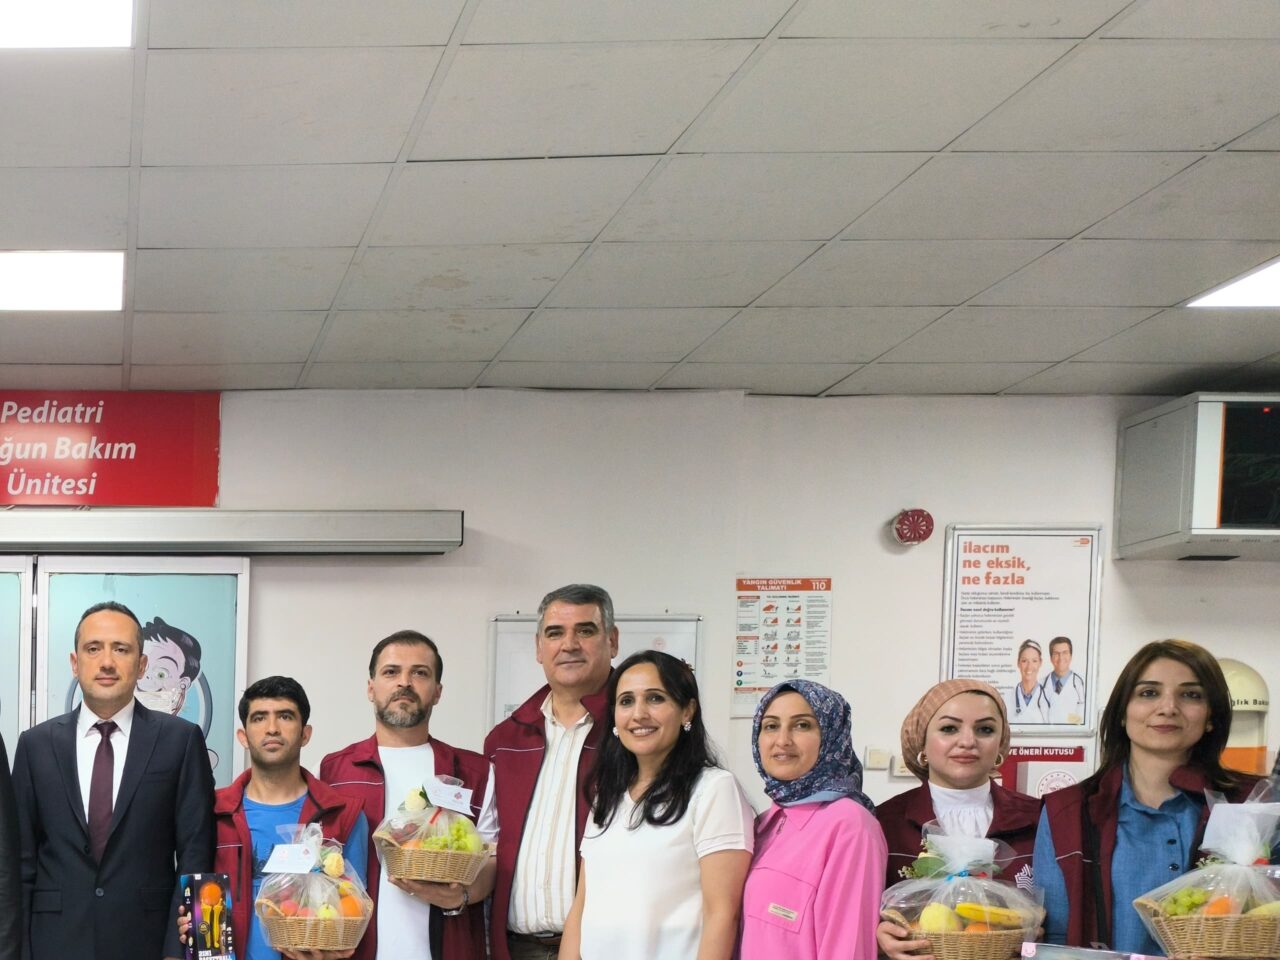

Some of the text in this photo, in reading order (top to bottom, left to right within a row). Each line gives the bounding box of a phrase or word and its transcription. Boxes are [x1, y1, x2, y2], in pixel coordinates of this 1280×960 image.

[0, 400, 104, 424] Pediatri
[54, 436, 136, 460] Bakım
[7, 468, 98, 496] Ünitesi
[963, 541, 1009, 554] ilacım
[962, 556, 1031, 571] ne eksik,
[962, 571, 1024, 585] ne fazla
[1019, 747, 1042, 756] ÖNERİ
